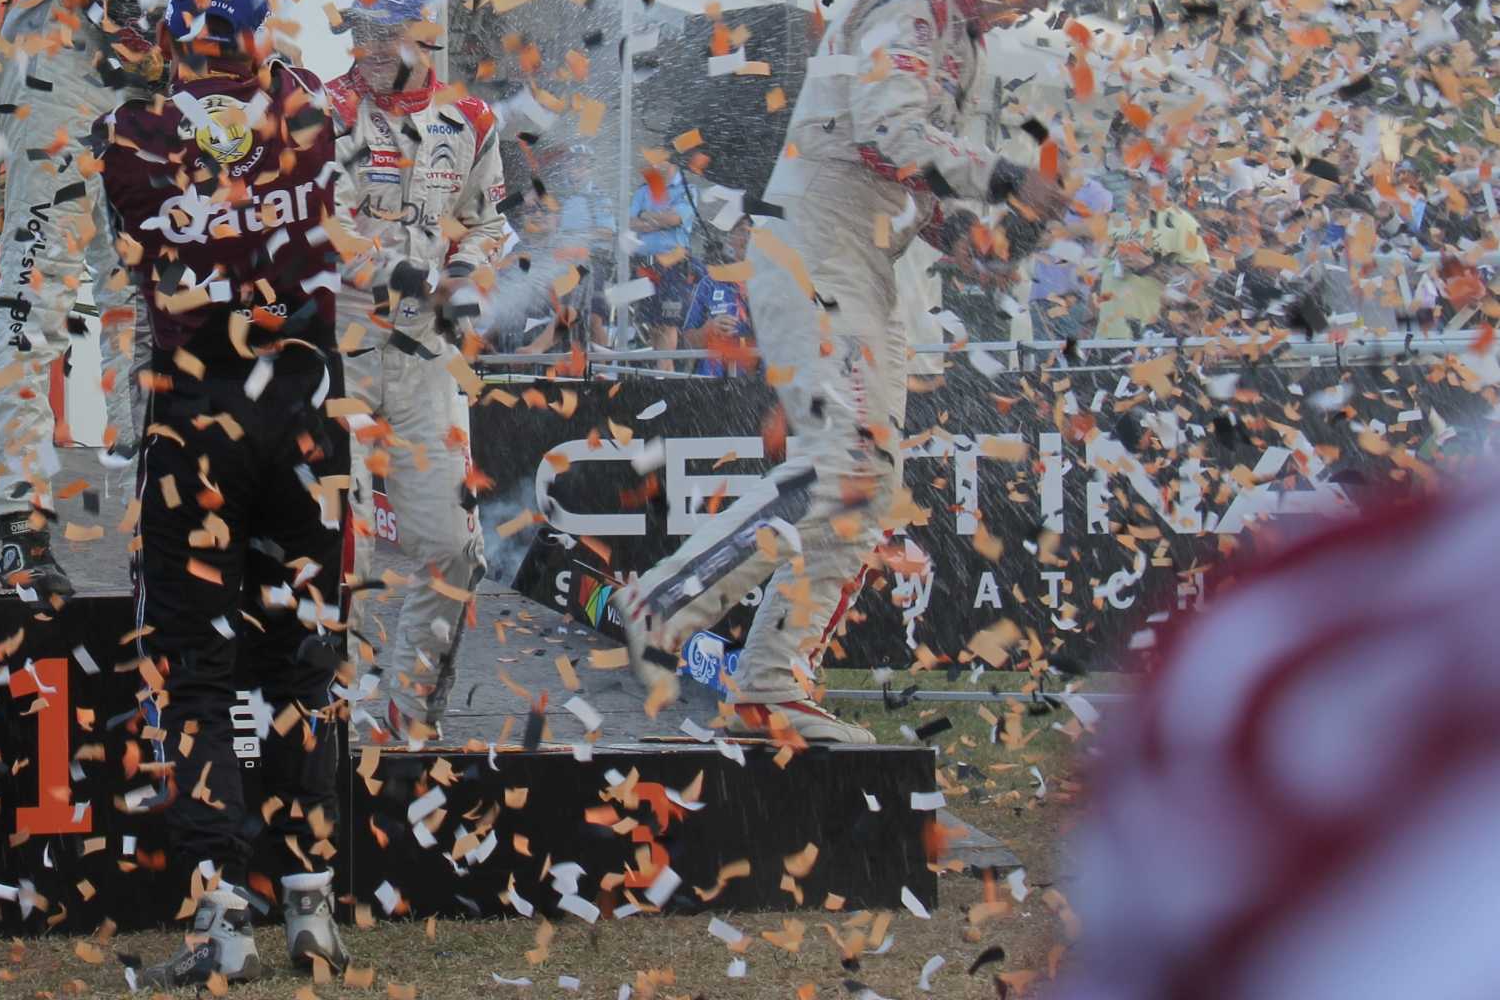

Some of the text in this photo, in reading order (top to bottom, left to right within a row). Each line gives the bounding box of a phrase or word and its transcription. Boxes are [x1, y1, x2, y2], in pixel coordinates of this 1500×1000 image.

[8, 202, 52, 349] Vokswgen
[159, 181, 314, 245] Qatar
[535, 433, 1362, 537] CETINA
[10, 657, 93, 834] 1
